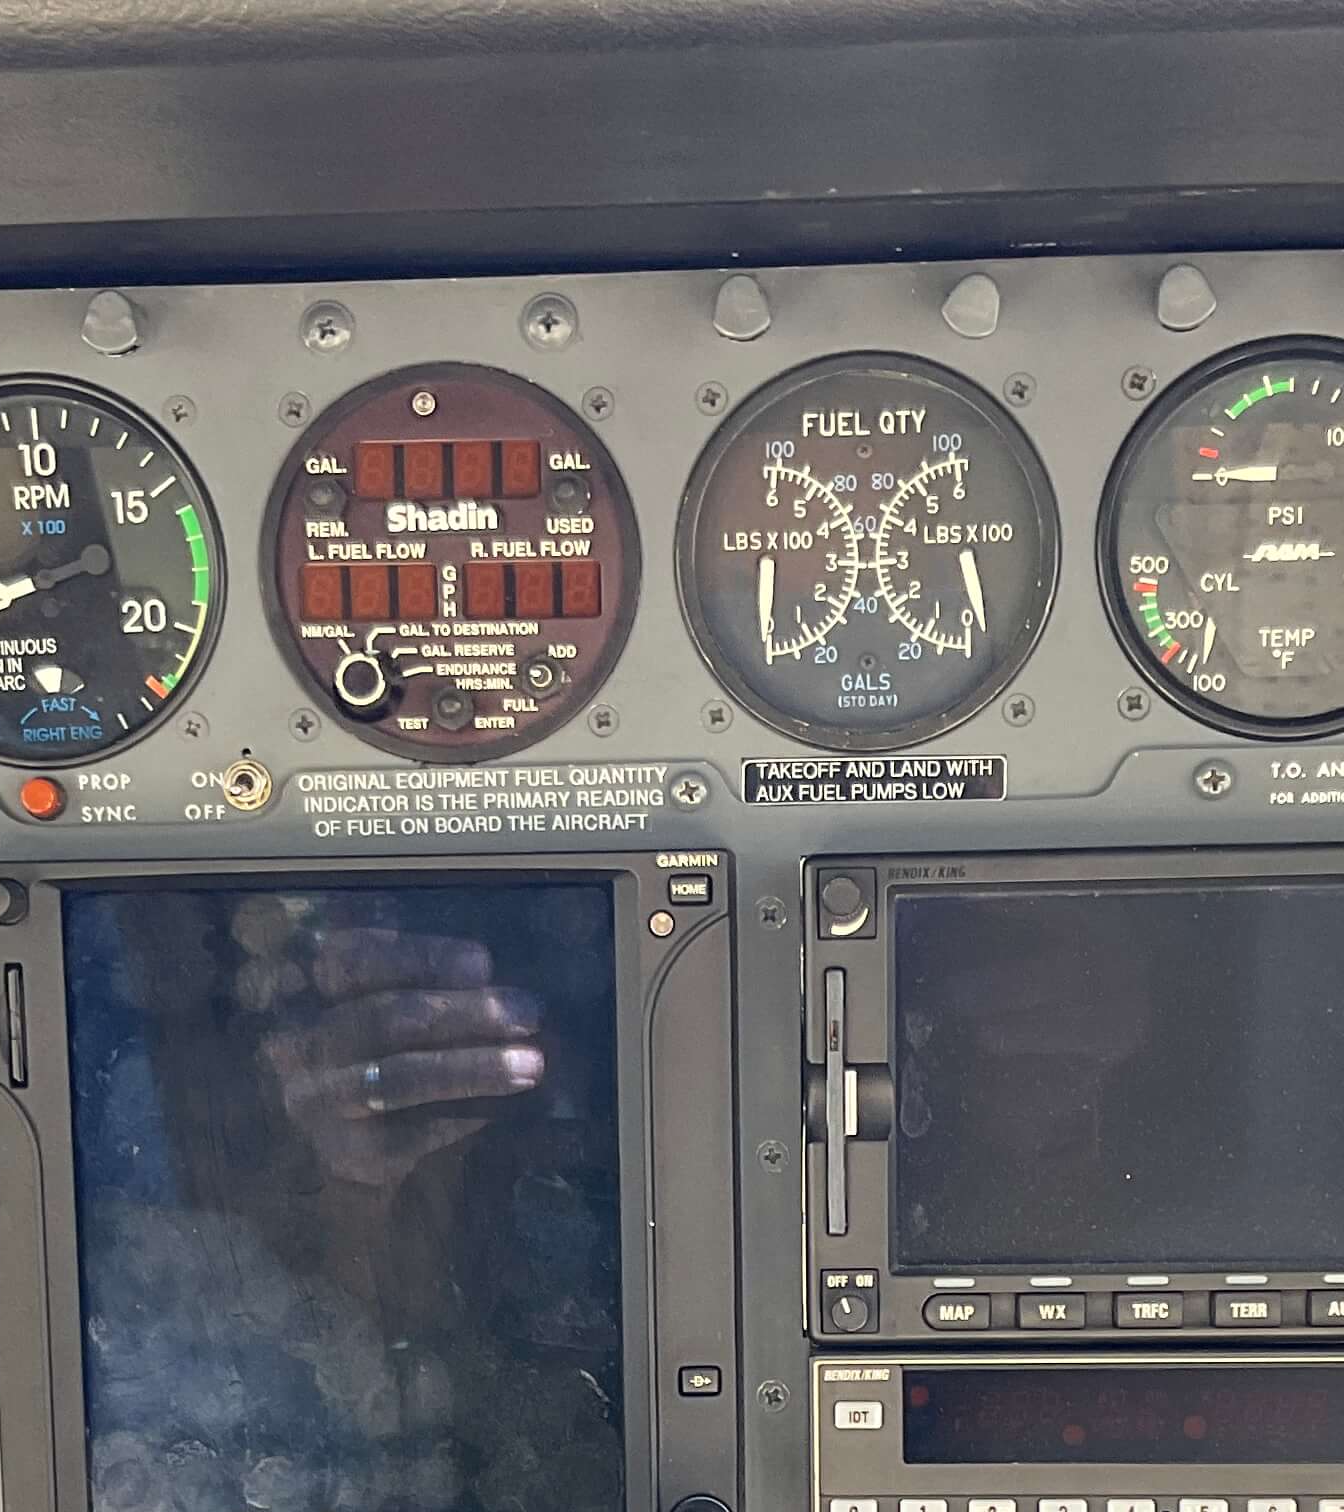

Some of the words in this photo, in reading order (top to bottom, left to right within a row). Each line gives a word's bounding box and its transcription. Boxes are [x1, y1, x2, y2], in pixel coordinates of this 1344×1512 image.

[802, 412, 870, 437] FUEL
[879, 409, 926, 434] QTY
[306, 459, 347, 474] GAL.
[549, 455, 591, 469] GAL.
[15, 485, 69, 510] RPM
[387, 503, 498, 534] Shadin
[1269, 507, 1304, 525] PSI
[306, 522, 349, 537] REM.
[546, 518, 594, 534] USED
[329, 545, 371, 560] FUEL
[376, 544, 426, 558] FLOW
[492, 542, 536, 557] FUEL
[540, 541, 591, 555] FLOW
[1260, 629, 1315, 647] TEMP
[7, 659, 22, 673] IN
[842, 674, 890, 691] GALS
[756, 763, 841, 780] TAKEOFF
[845, 762, 885, 778] AND
[890, 761, 940, 777] LAND
[945, 760, 993, 777] WITH
[1272, 762, 1306, 779] T.O.
[78, 775, 131, 791] PROP
[298, 774, 391, 792] ORIGINAL
[395, 771, 509, 789] EQUIPMENT
[515, 770, 564, 787] FUEL
[569, 767, 667, 786] QUANTITY
[756, 785, 794, 801] AUX
[799, 785, 846, 801] FUEL
[852, 783, 916, 800] PUMPS
[922, 782, 965, 799] LOW
[304, 795, 409, 813] INDICATOR
[415, 795, 433, 811] IS
[439, 795, 477, 810] THE
[483, 792, 570, 809] PRIMARY
[577, 790, 663, 807] READING
[82, 805, 136, 822] SYNC
[185, 805, 225, 820] OFF
[316, 821, 341, 837] OF
[347, 819, 395, 835] FUEL
[401, 818, 428, 834] ON
[435, 816, 502, 834] BOARD
[508, 816, 544, 831] THE
[552, 813, 648, 831] AIRCRAFT
[656, 854, 718, 868] GARMIN
[672, 883, 706, 895] HOME
[940, 1306, 974, 1321] MAP
